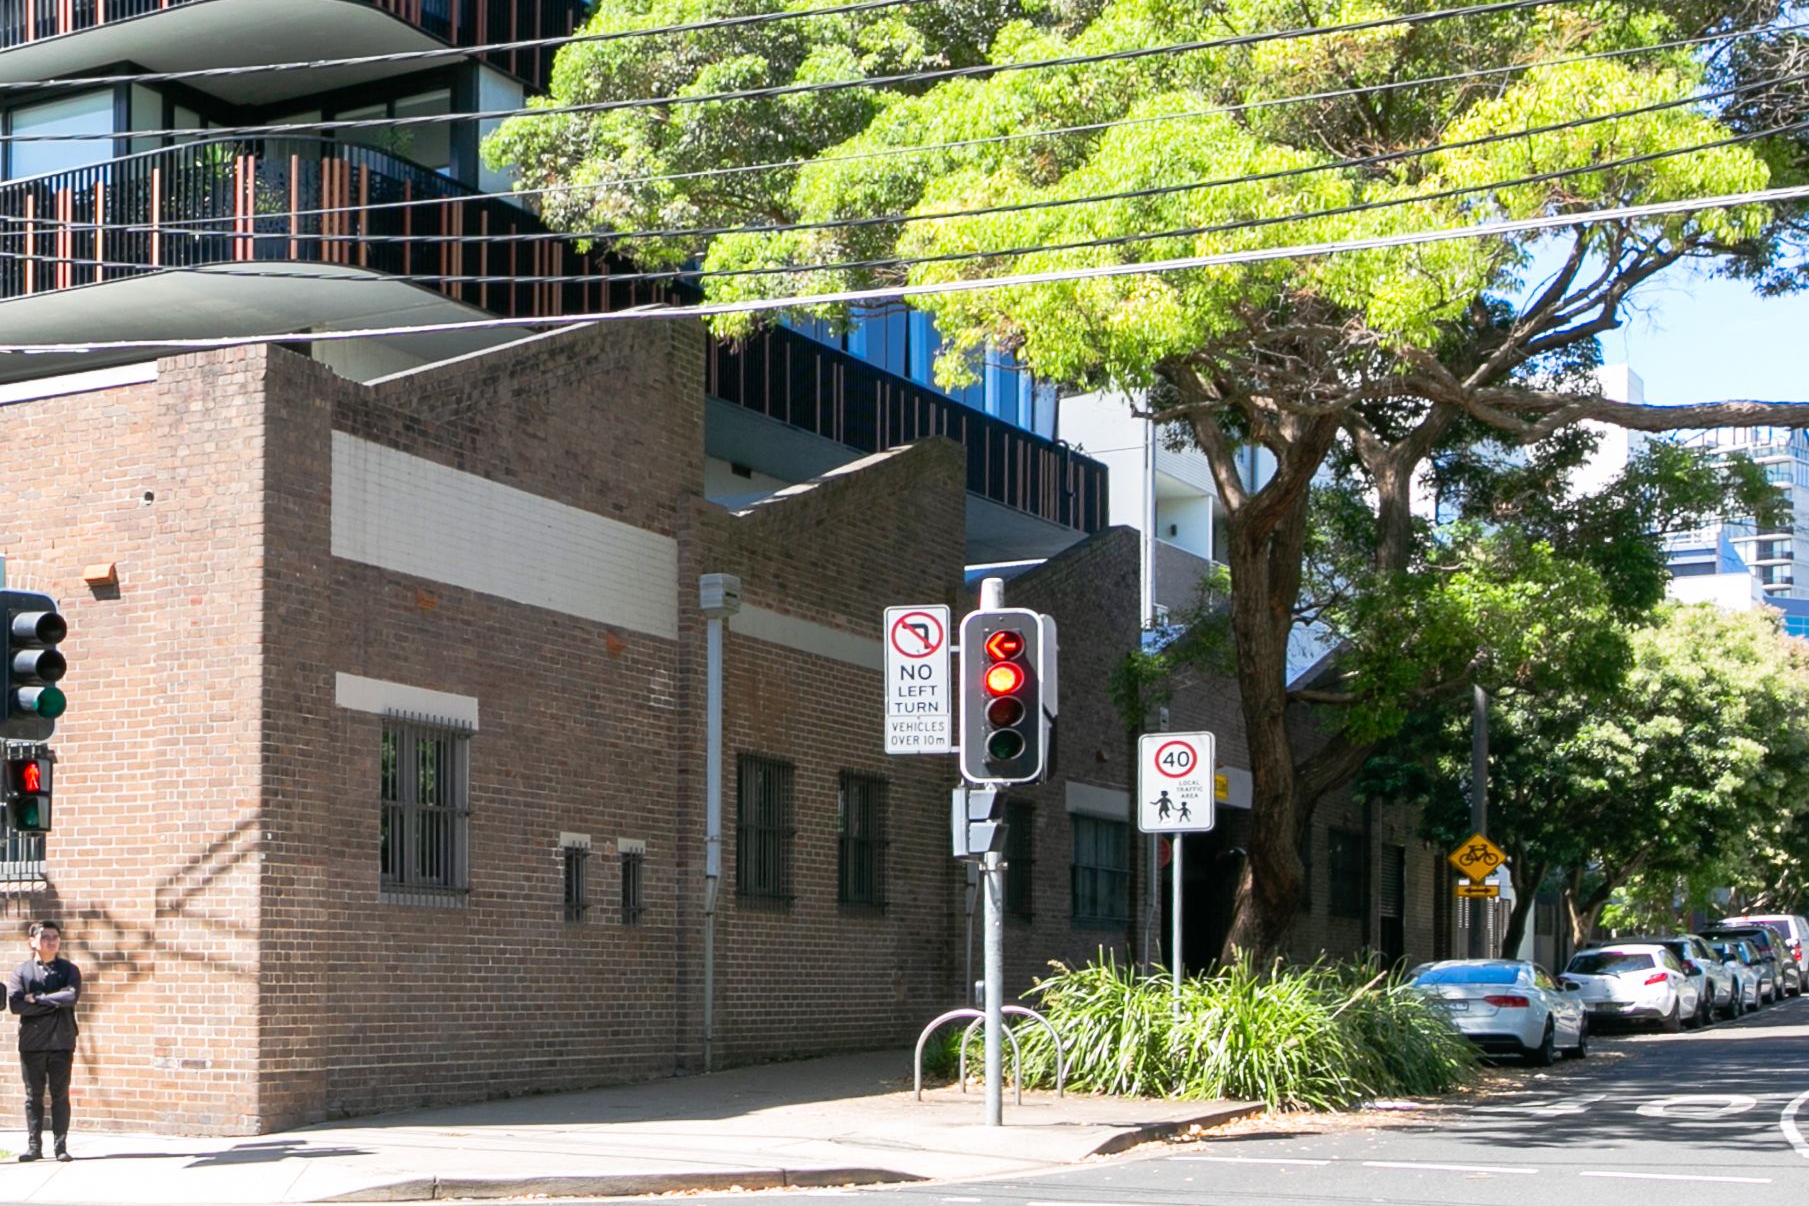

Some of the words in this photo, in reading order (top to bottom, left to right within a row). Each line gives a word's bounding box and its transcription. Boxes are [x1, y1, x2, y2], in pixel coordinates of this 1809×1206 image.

[900, 664, 933, 681] NO
[898, 685, 938, 697] LEFT
[895, 702, 938, 713] TURN
[892, 722, 945, 732] VEHICLES
[891, 735, 920, 745] OVER
[1162, 751, 1190, 767] 40
